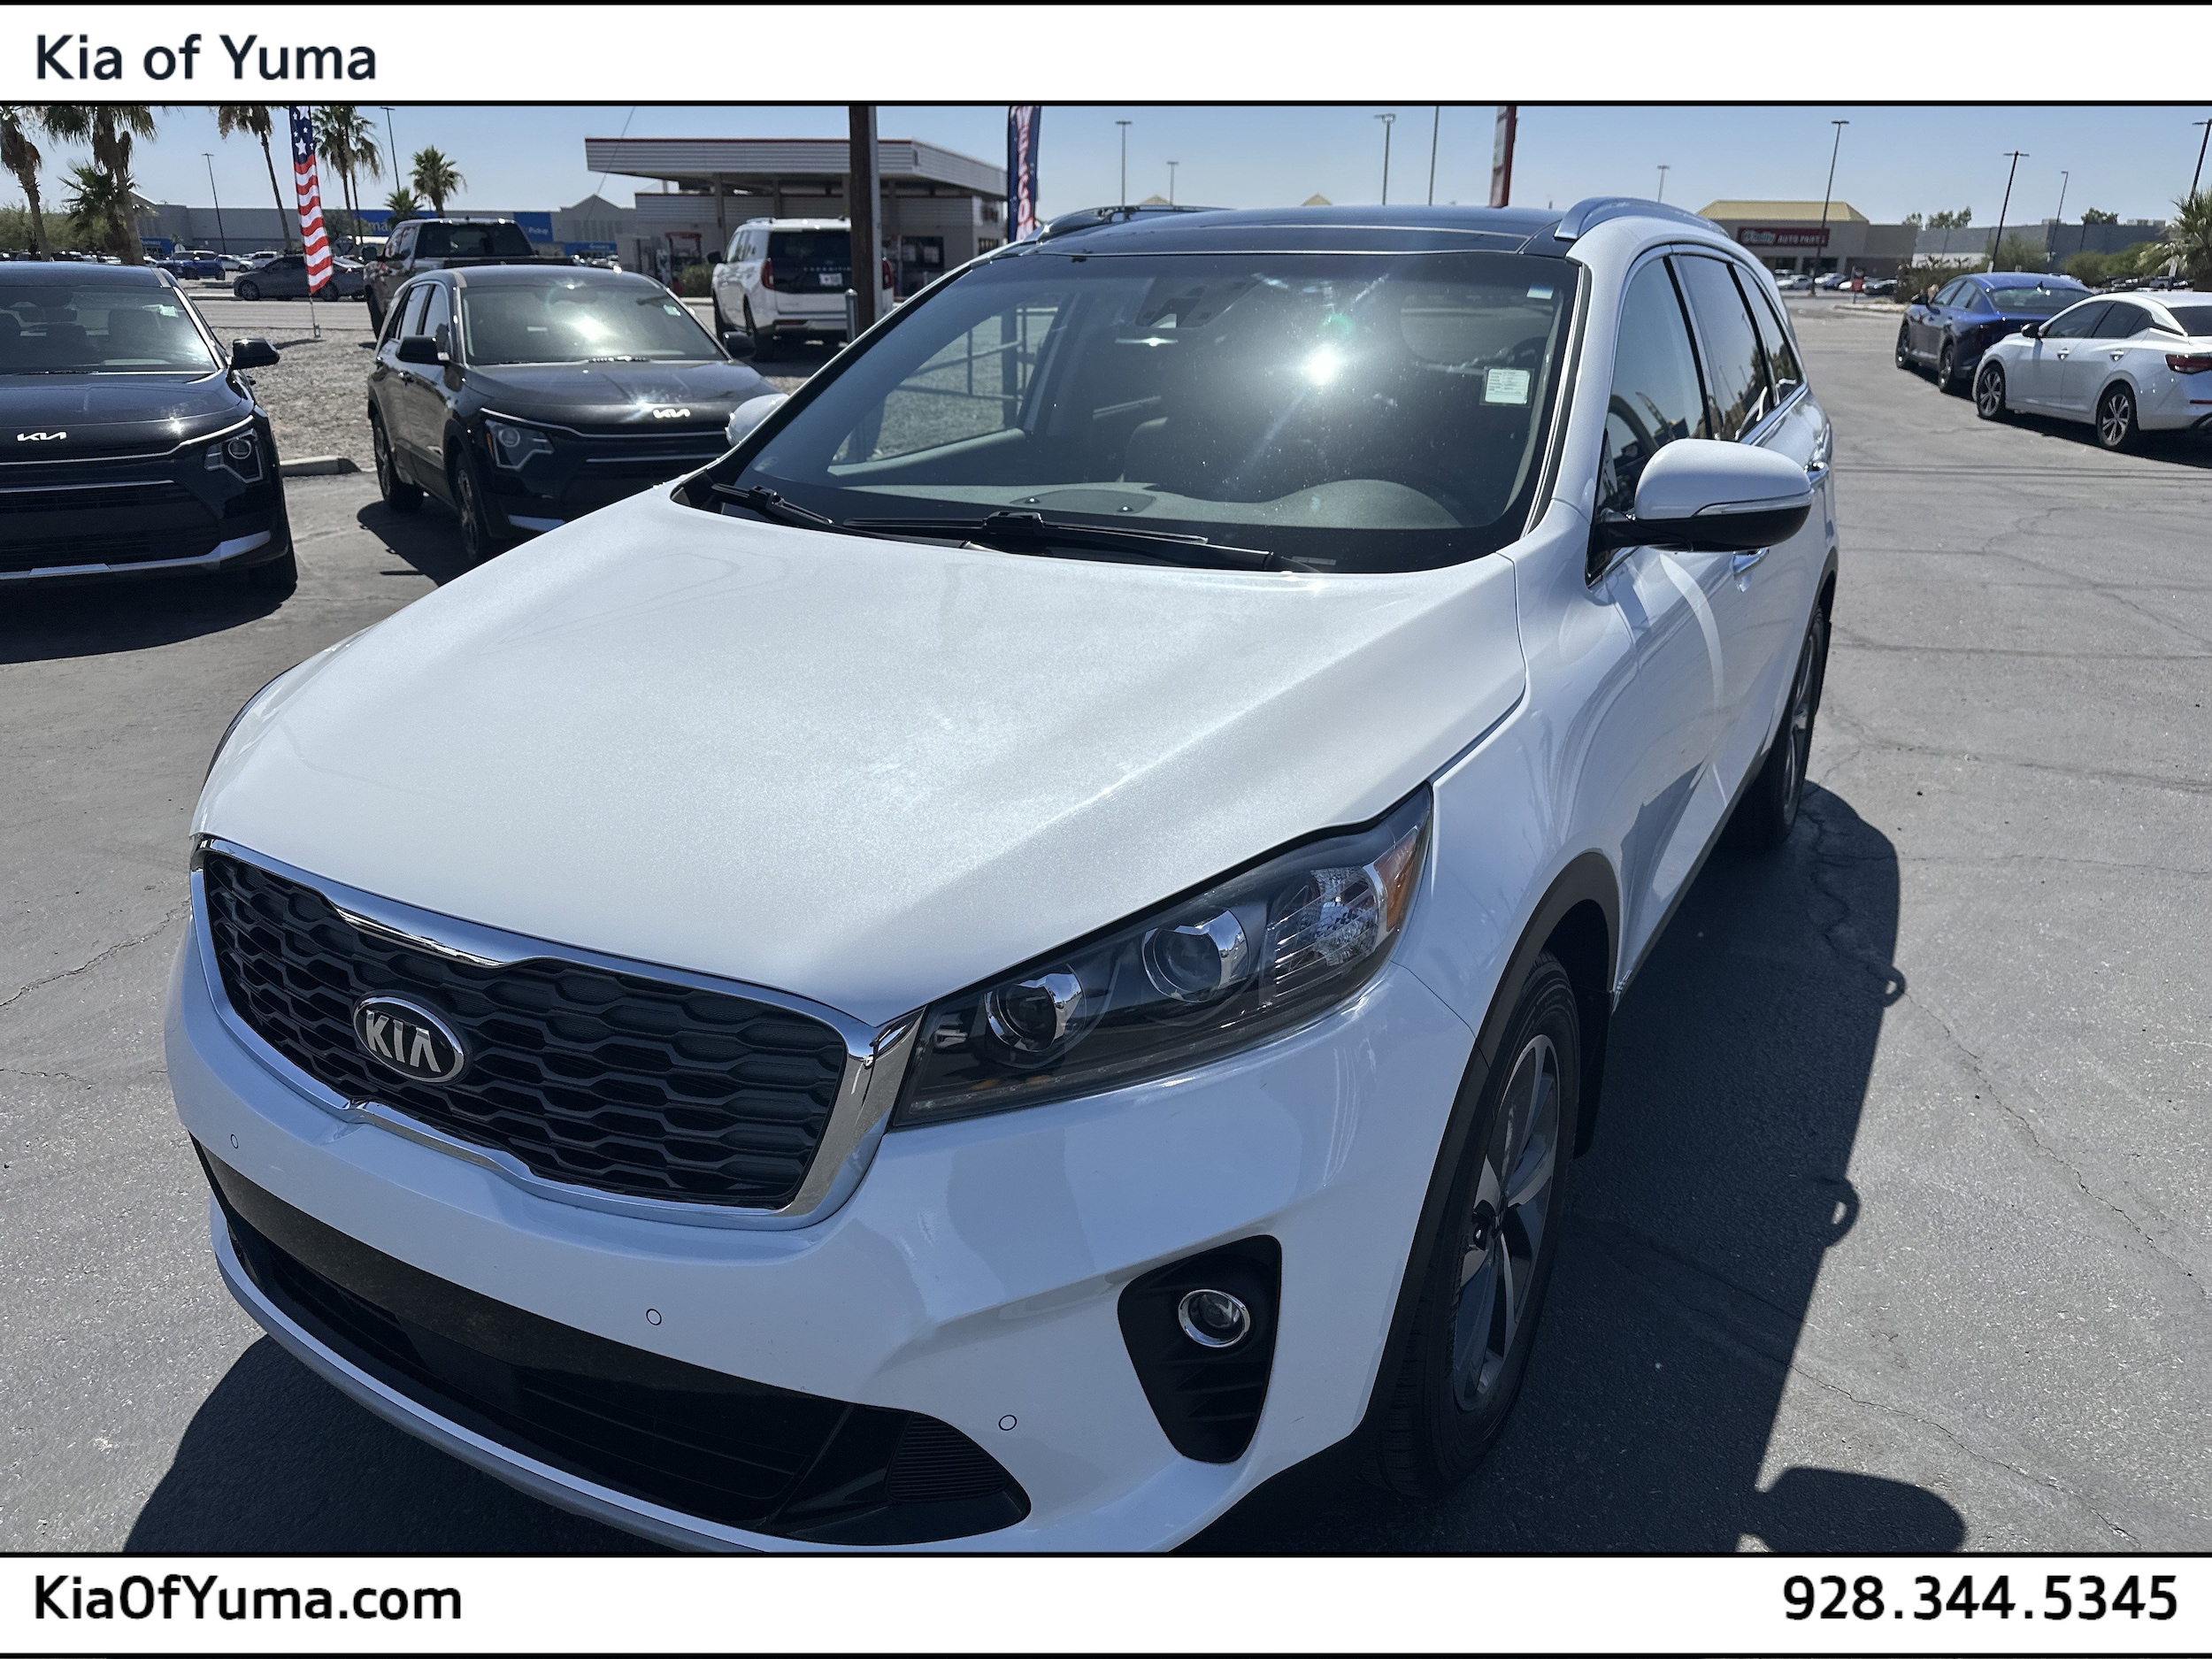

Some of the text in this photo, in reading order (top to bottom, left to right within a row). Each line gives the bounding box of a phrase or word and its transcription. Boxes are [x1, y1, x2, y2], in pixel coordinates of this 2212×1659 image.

[1016, 105, 1034, 241] WELCOM
[1777, 234, 1799, 244] AUTO
[365, 1009, 442, 1073] KIA
